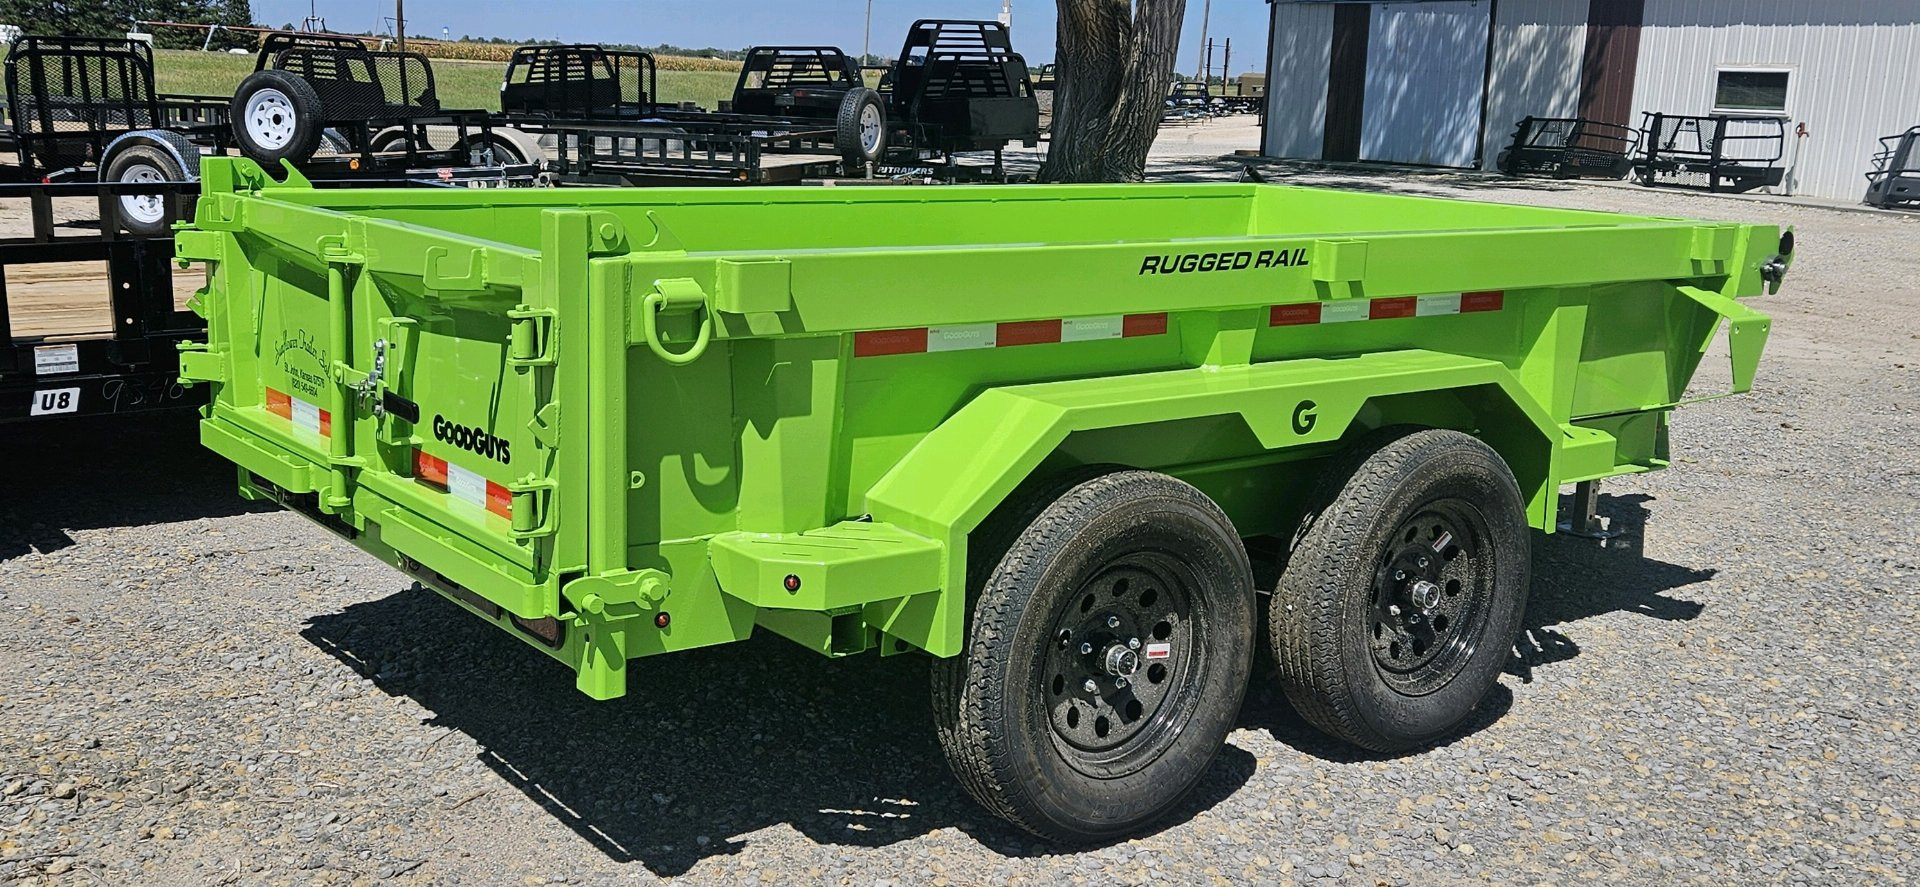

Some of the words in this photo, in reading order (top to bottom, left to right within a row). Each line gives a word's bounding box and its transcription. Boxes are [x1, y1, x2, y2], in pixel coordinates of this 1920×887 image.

[1138, 251, 1253, 275] RUGGED
[1254, 248, 1309, 269] RAIL
[41, 392, 71, 411] U8
[1291, 399, 1318, 436] G
[433, 414, 511, 465] GOODGUYS
